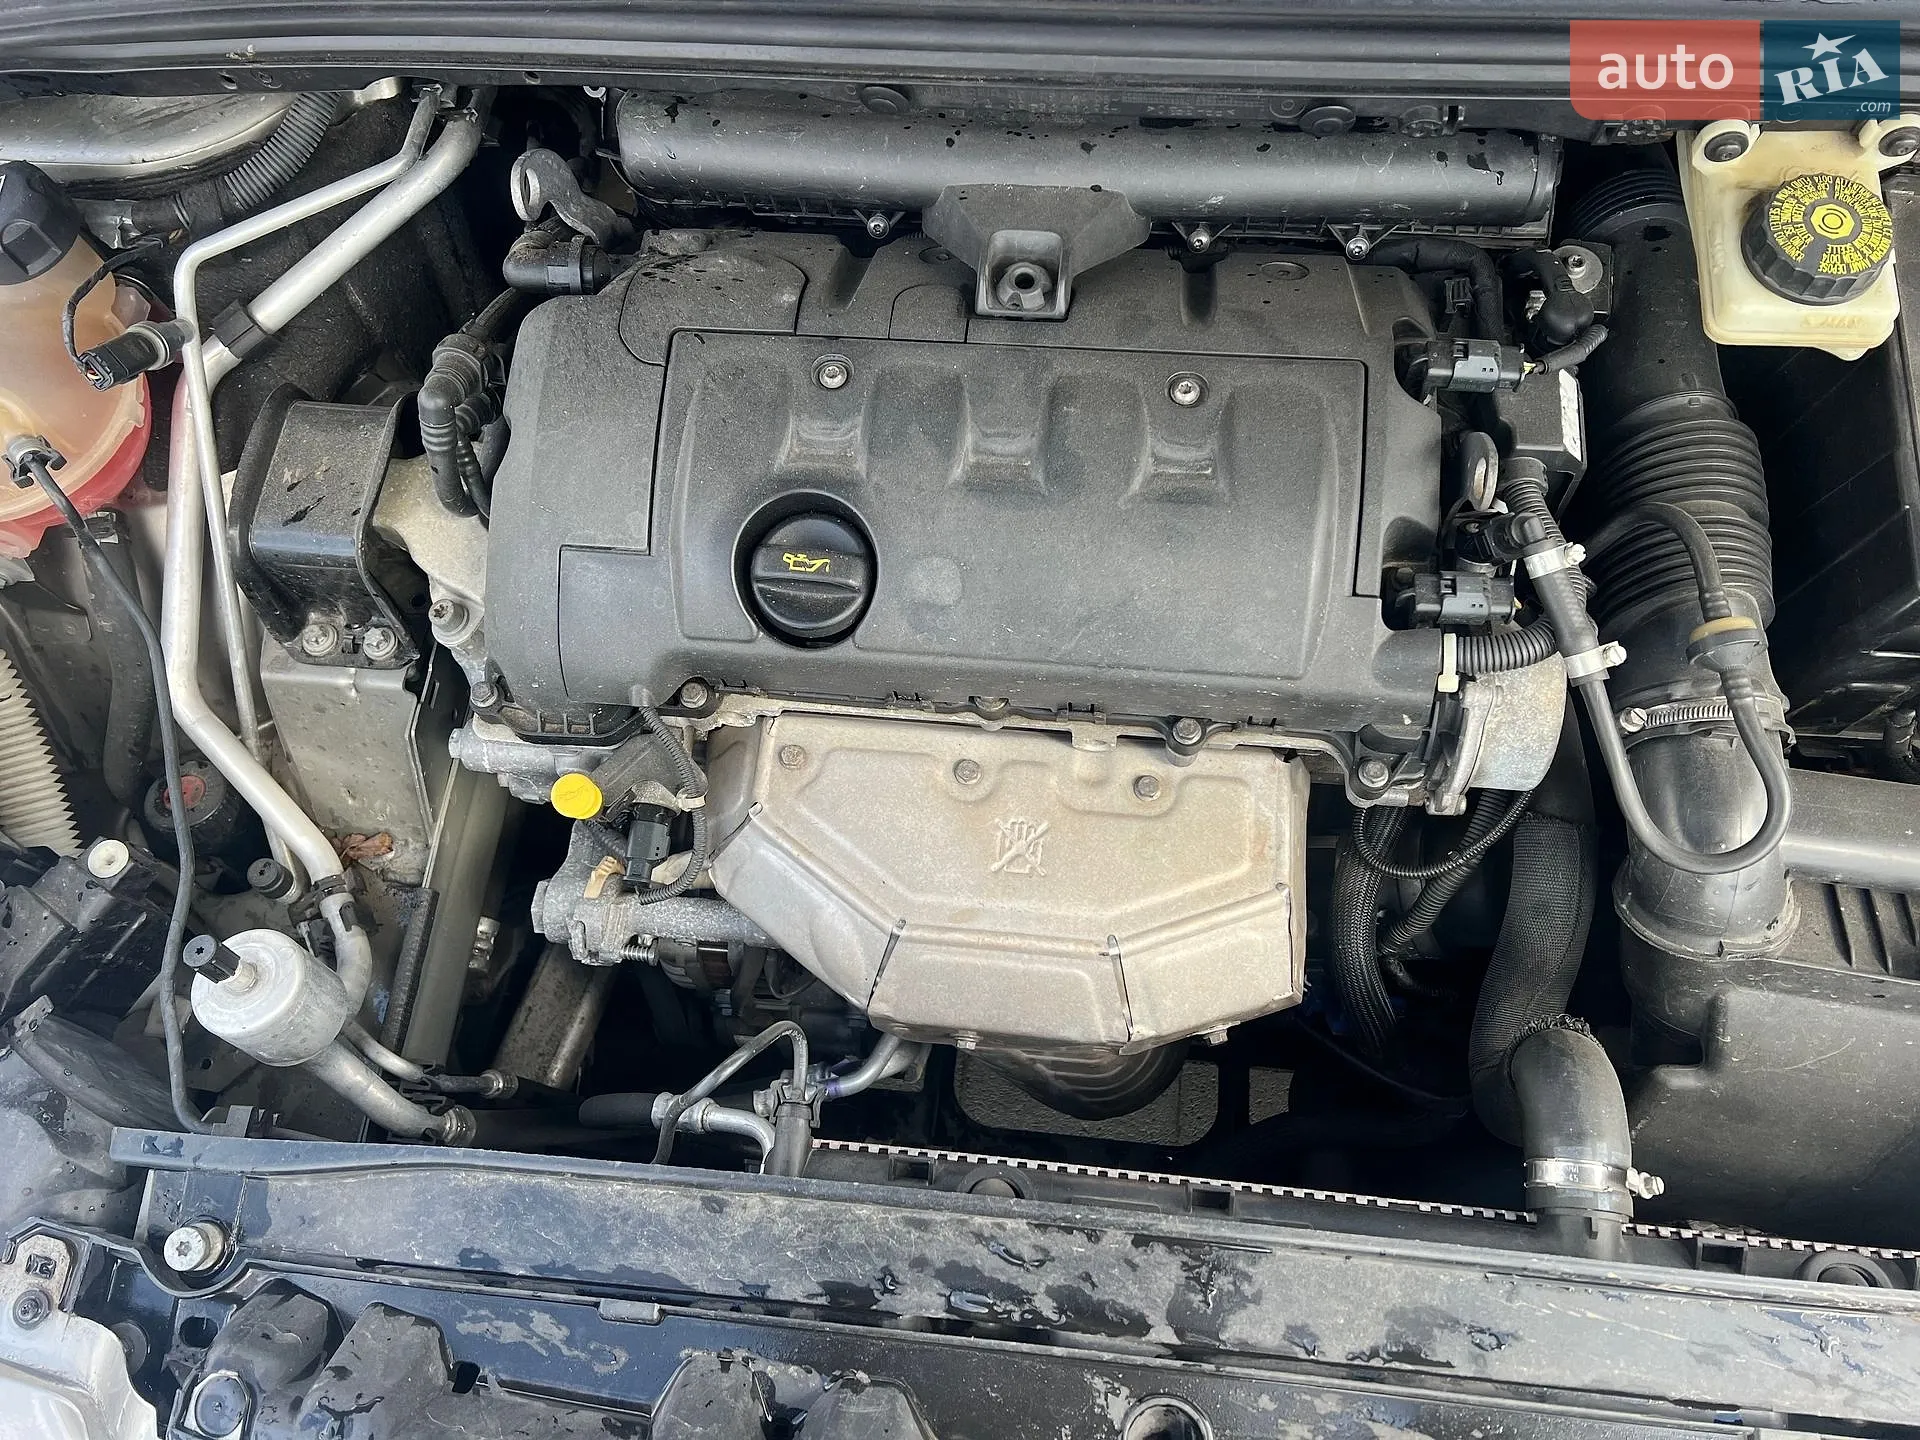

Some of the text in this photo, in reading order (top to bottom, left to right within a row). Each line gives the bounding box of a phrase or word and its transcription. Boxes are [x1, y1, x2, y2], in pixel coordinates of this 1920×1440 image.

[1836, 177, 1874, 198] ATTENTION
[1883, 228, 1893, 238] CE
[1860, 245, 1873, 257] DE
[1822, 253, 1841, 263] DOT4
[1817, 261, 1847, 274] DEPOSE
